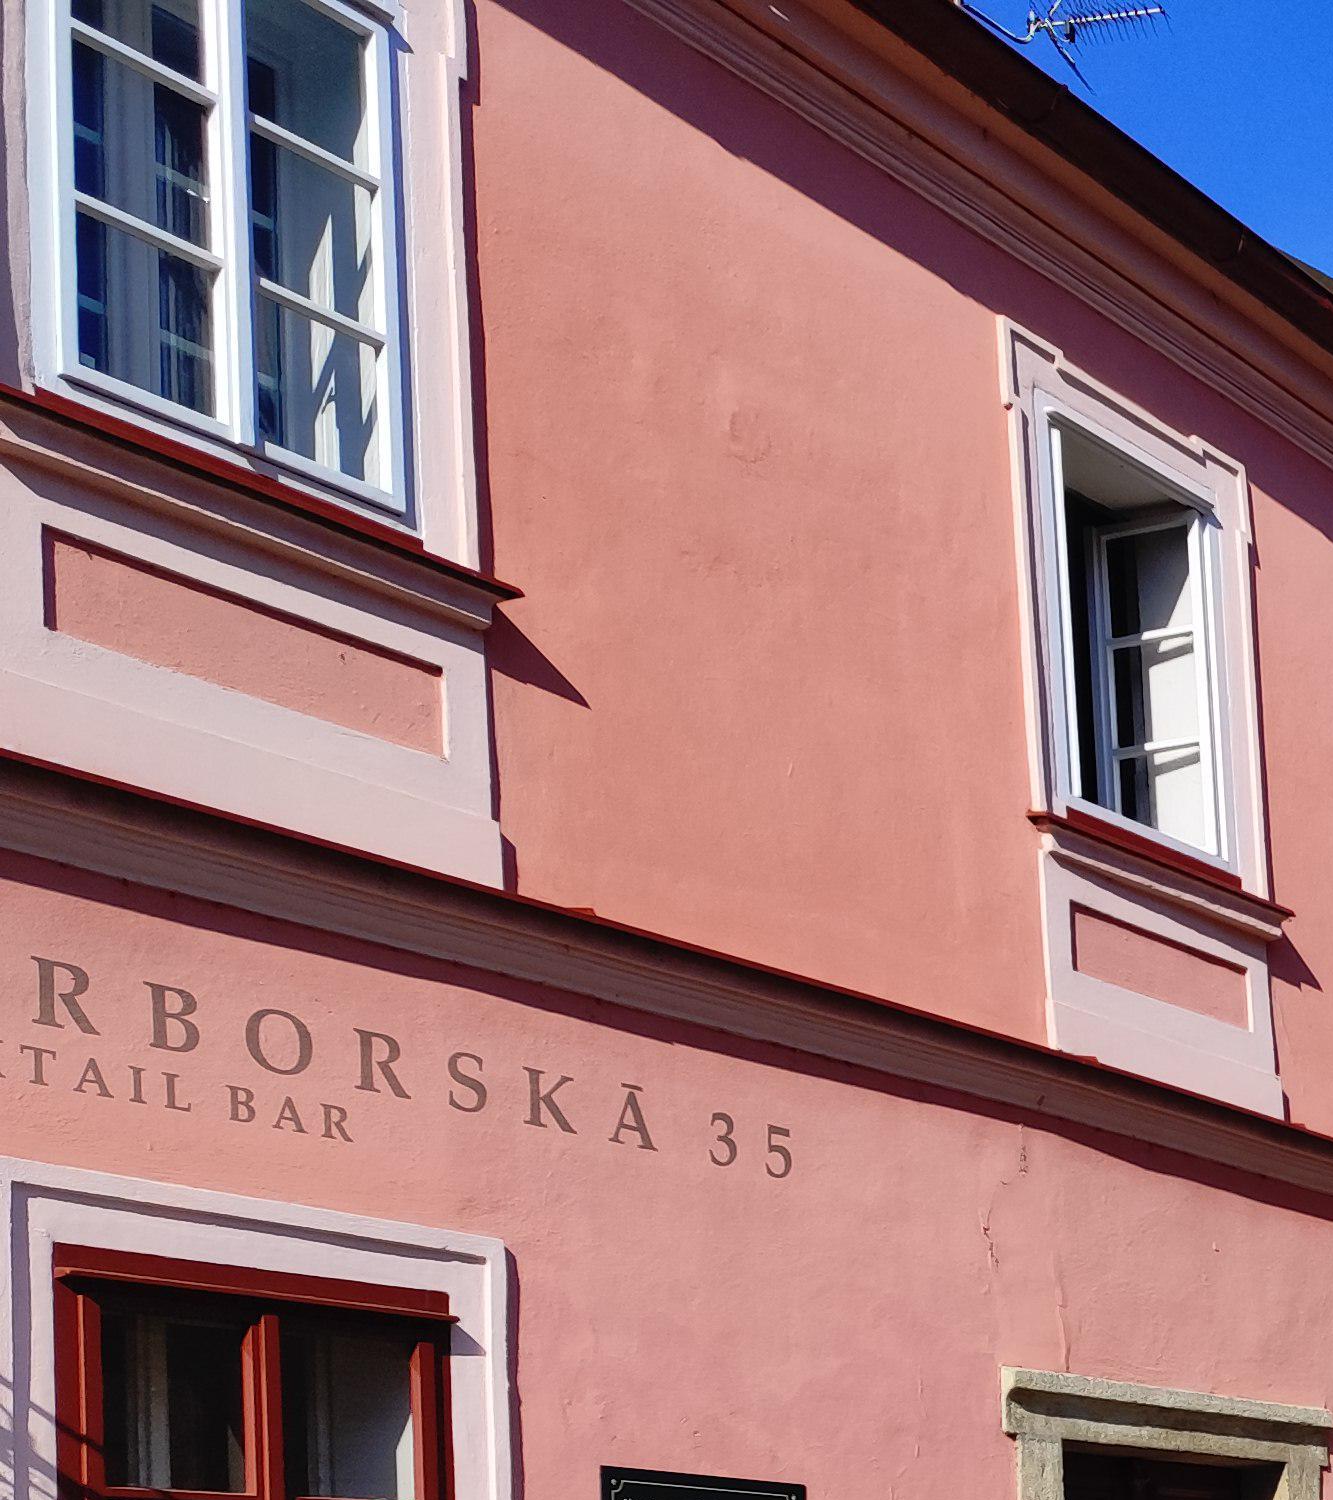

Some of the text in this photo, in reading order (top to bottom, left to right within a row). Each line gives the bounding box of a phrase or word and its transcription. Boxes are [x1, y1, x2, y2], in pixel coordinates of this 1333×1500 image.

[0, 1039, 354, 1143] TAIL BAR
[709, 1112, 793, 1179] 35
